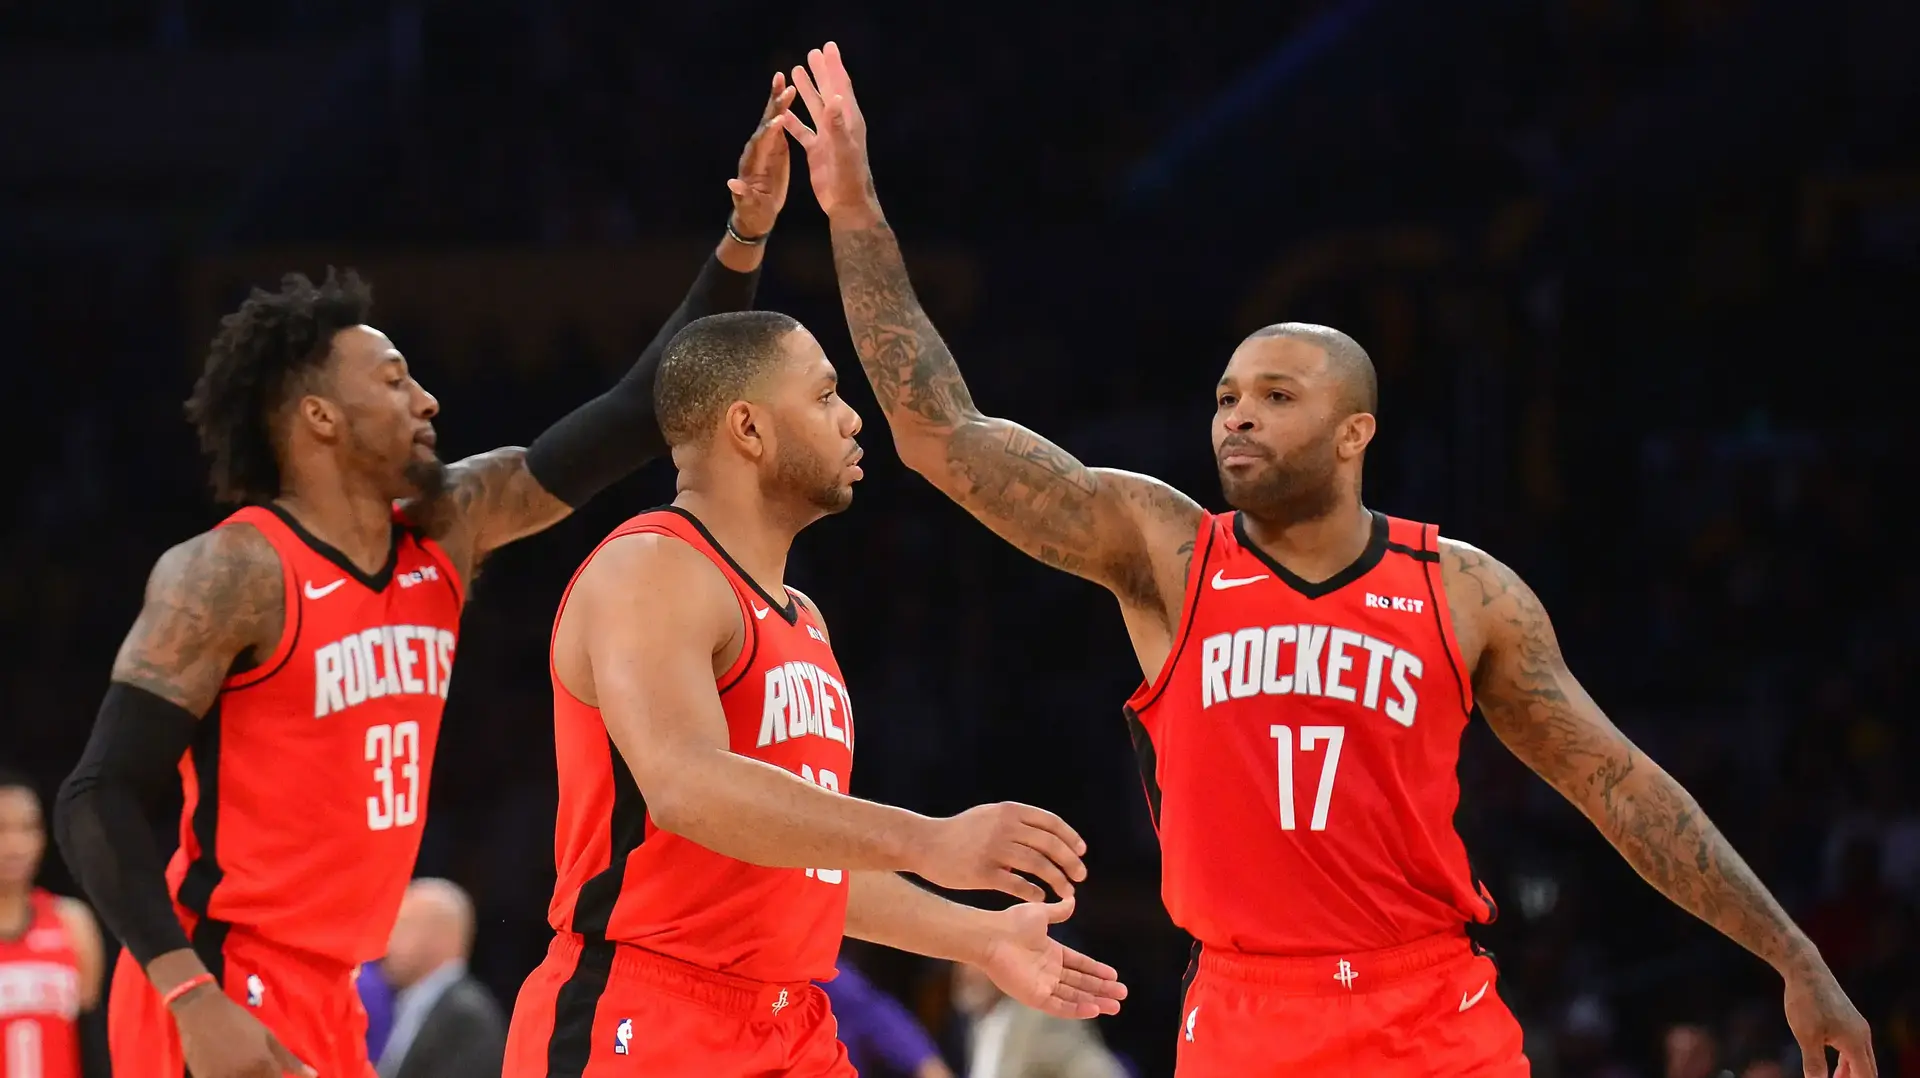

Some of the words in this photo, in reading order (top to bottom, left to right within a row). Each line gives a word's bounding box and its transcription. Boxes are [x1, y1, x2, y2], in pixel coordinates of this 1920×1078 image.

[315, 625, 456, 719] ROCKETS
[756, 661, 854, 752] ROCKET
[1202, 623, 1424, 729] ROCKETS
[365, 721, 420, 831] 33
[1270, 724, 1345, 831] 17
